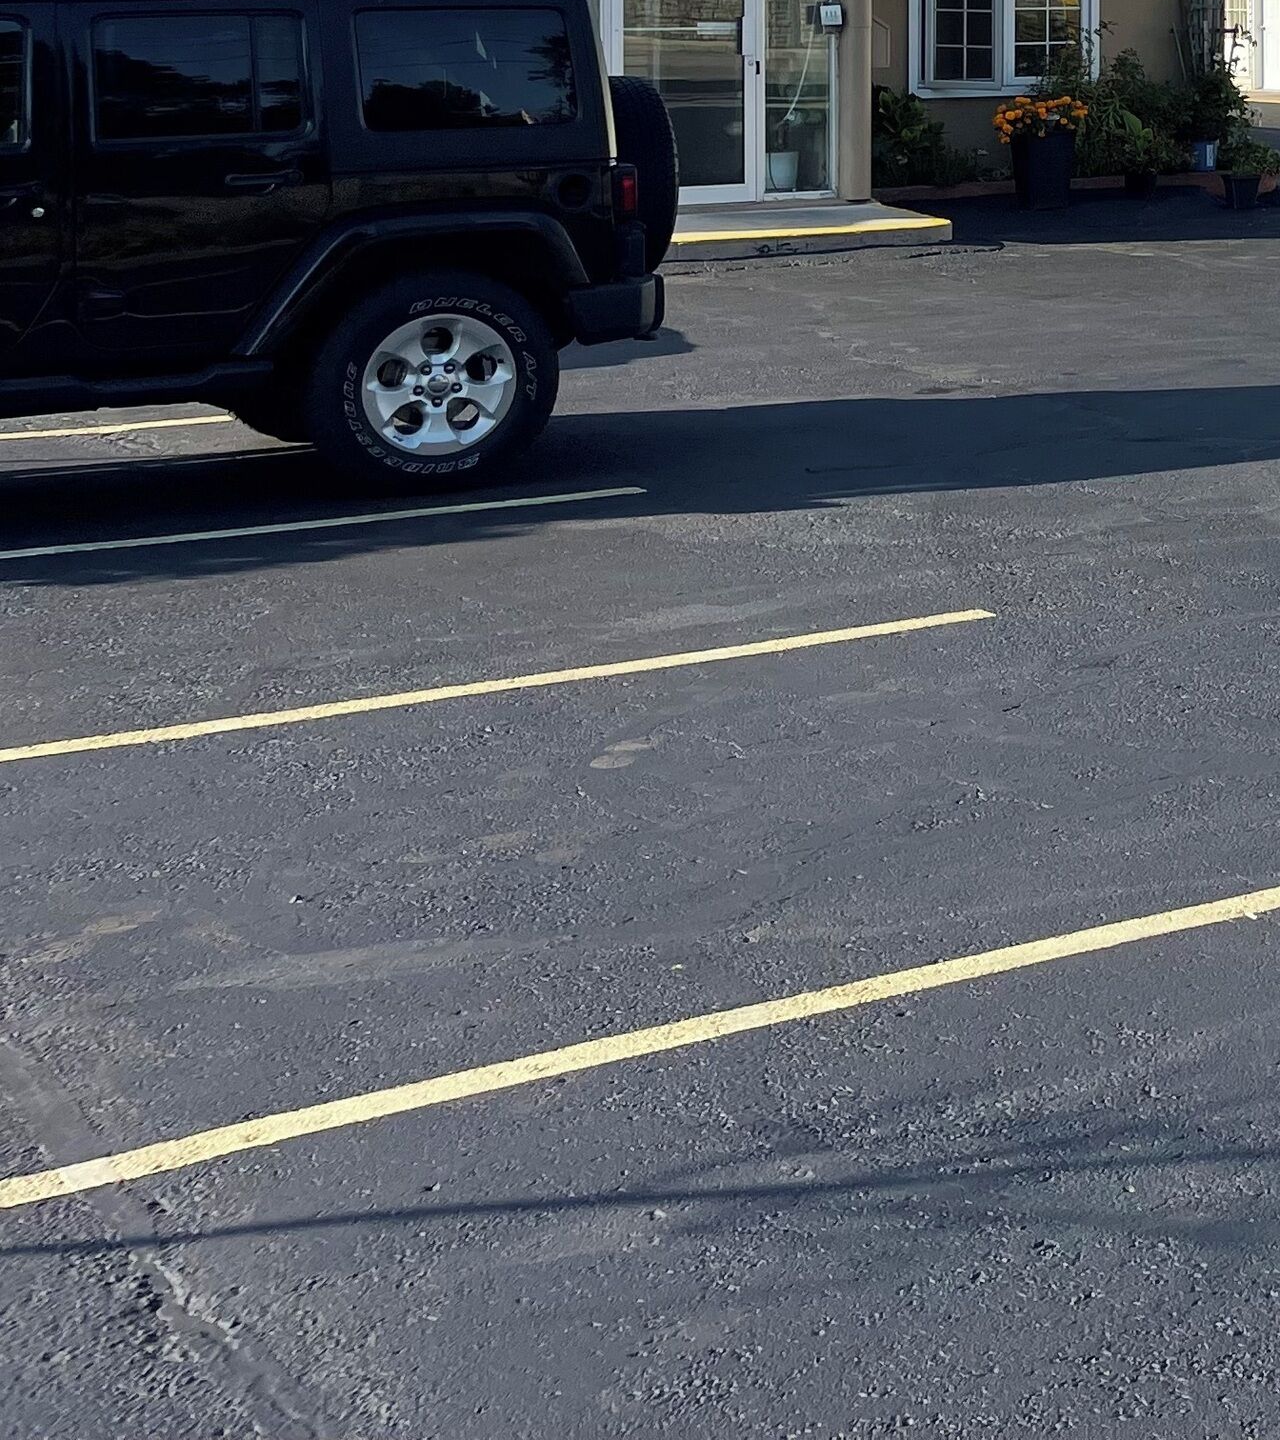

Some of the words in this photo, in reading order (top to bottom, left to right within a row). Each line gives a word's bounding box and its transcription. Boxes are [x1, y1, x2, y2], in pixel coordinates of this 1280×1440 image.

[409, 296, 528, 344] DUELER
[522, 351, 539, 400] A/T
[343, 361, 481, 474] BRIDGESTONE
